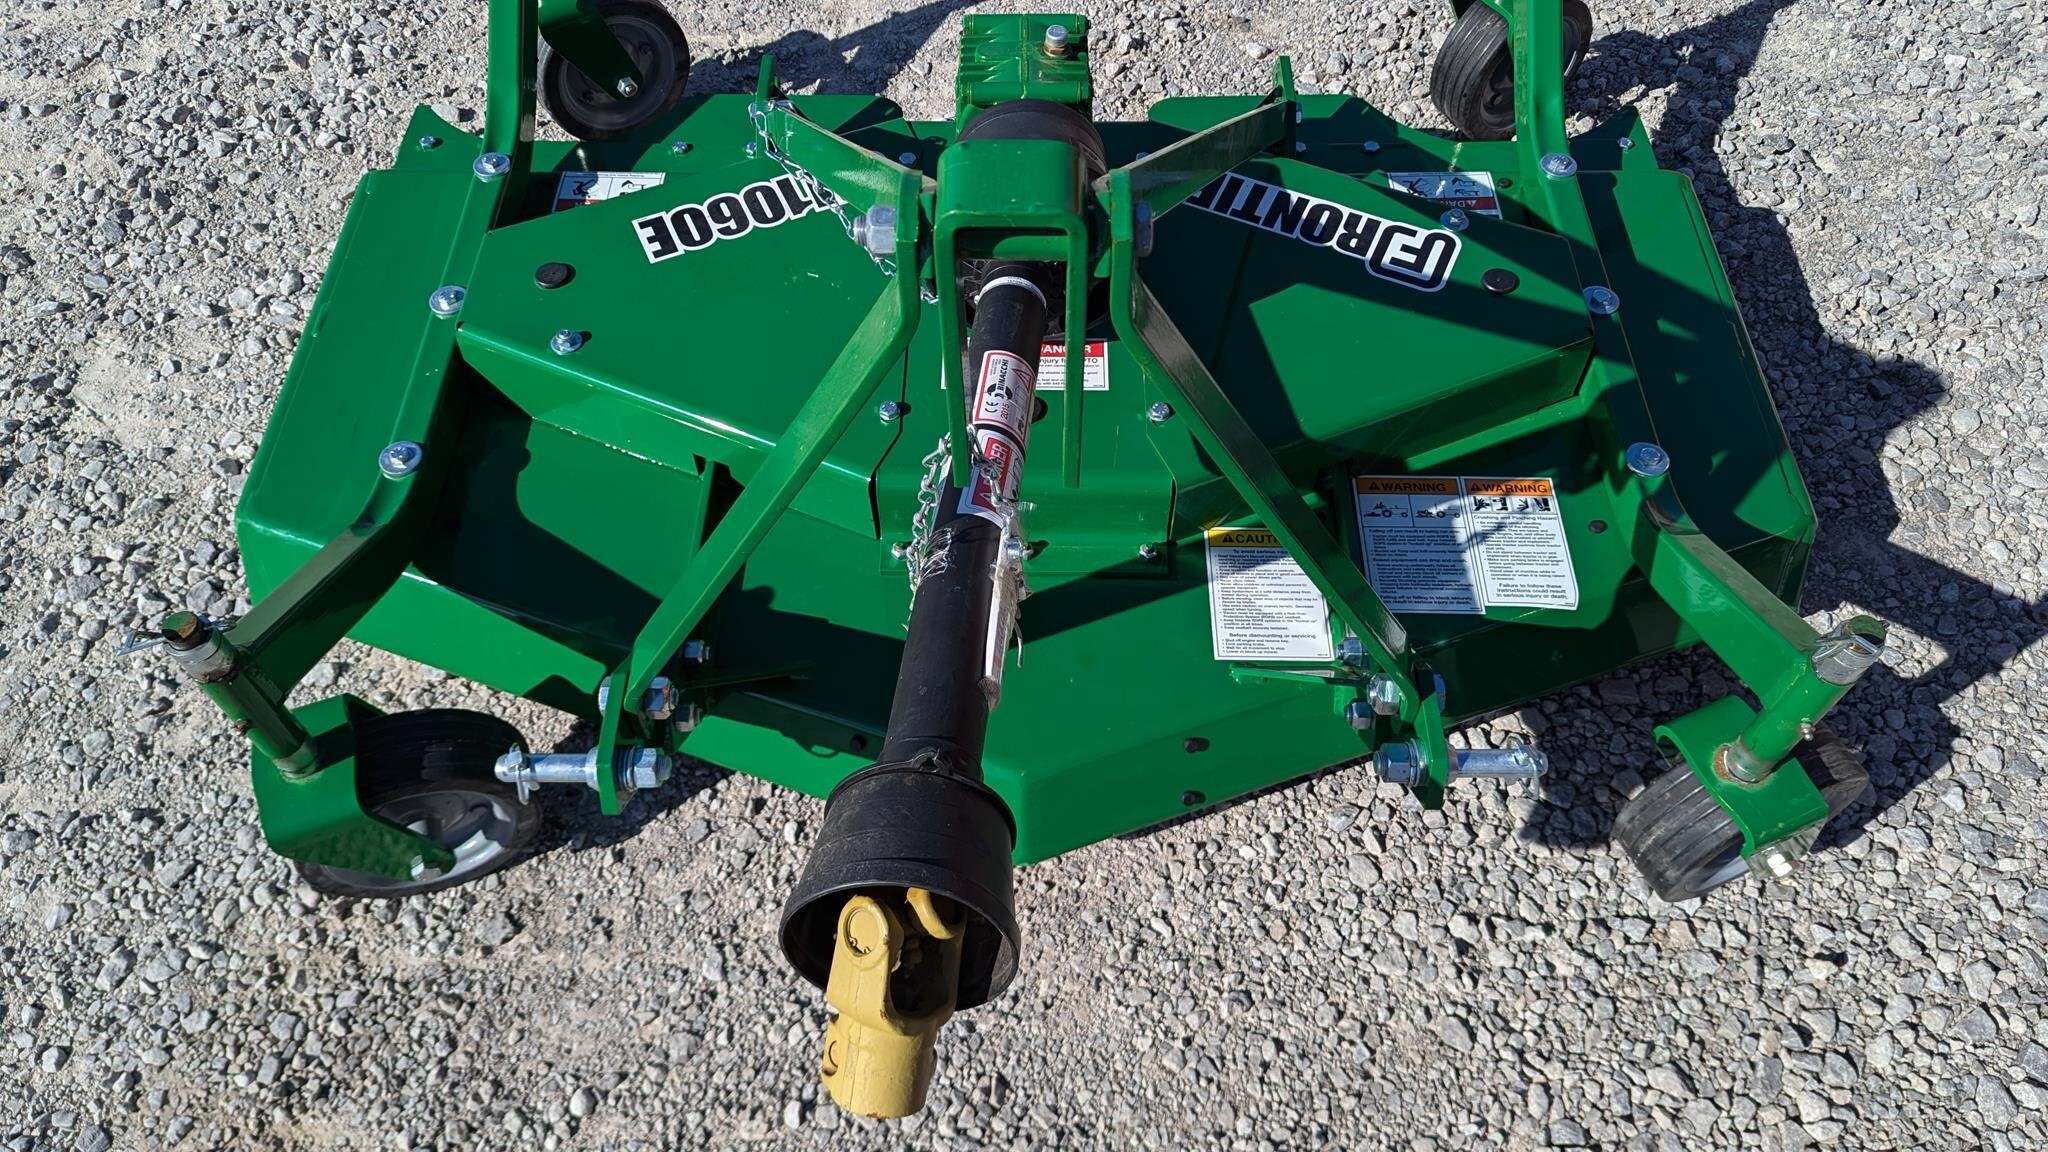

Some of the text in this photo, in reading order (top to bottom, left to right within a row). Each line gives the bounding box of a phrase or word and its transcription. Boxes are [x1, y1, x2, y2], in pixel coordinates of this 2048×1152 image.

[997, 359, 1010, 391] BINACCHI
[1000, 402, 1010, 420] 2015
[1382, 483, 1448, 493] WARNING
[1482, 484, 1548, 494] WARNING
